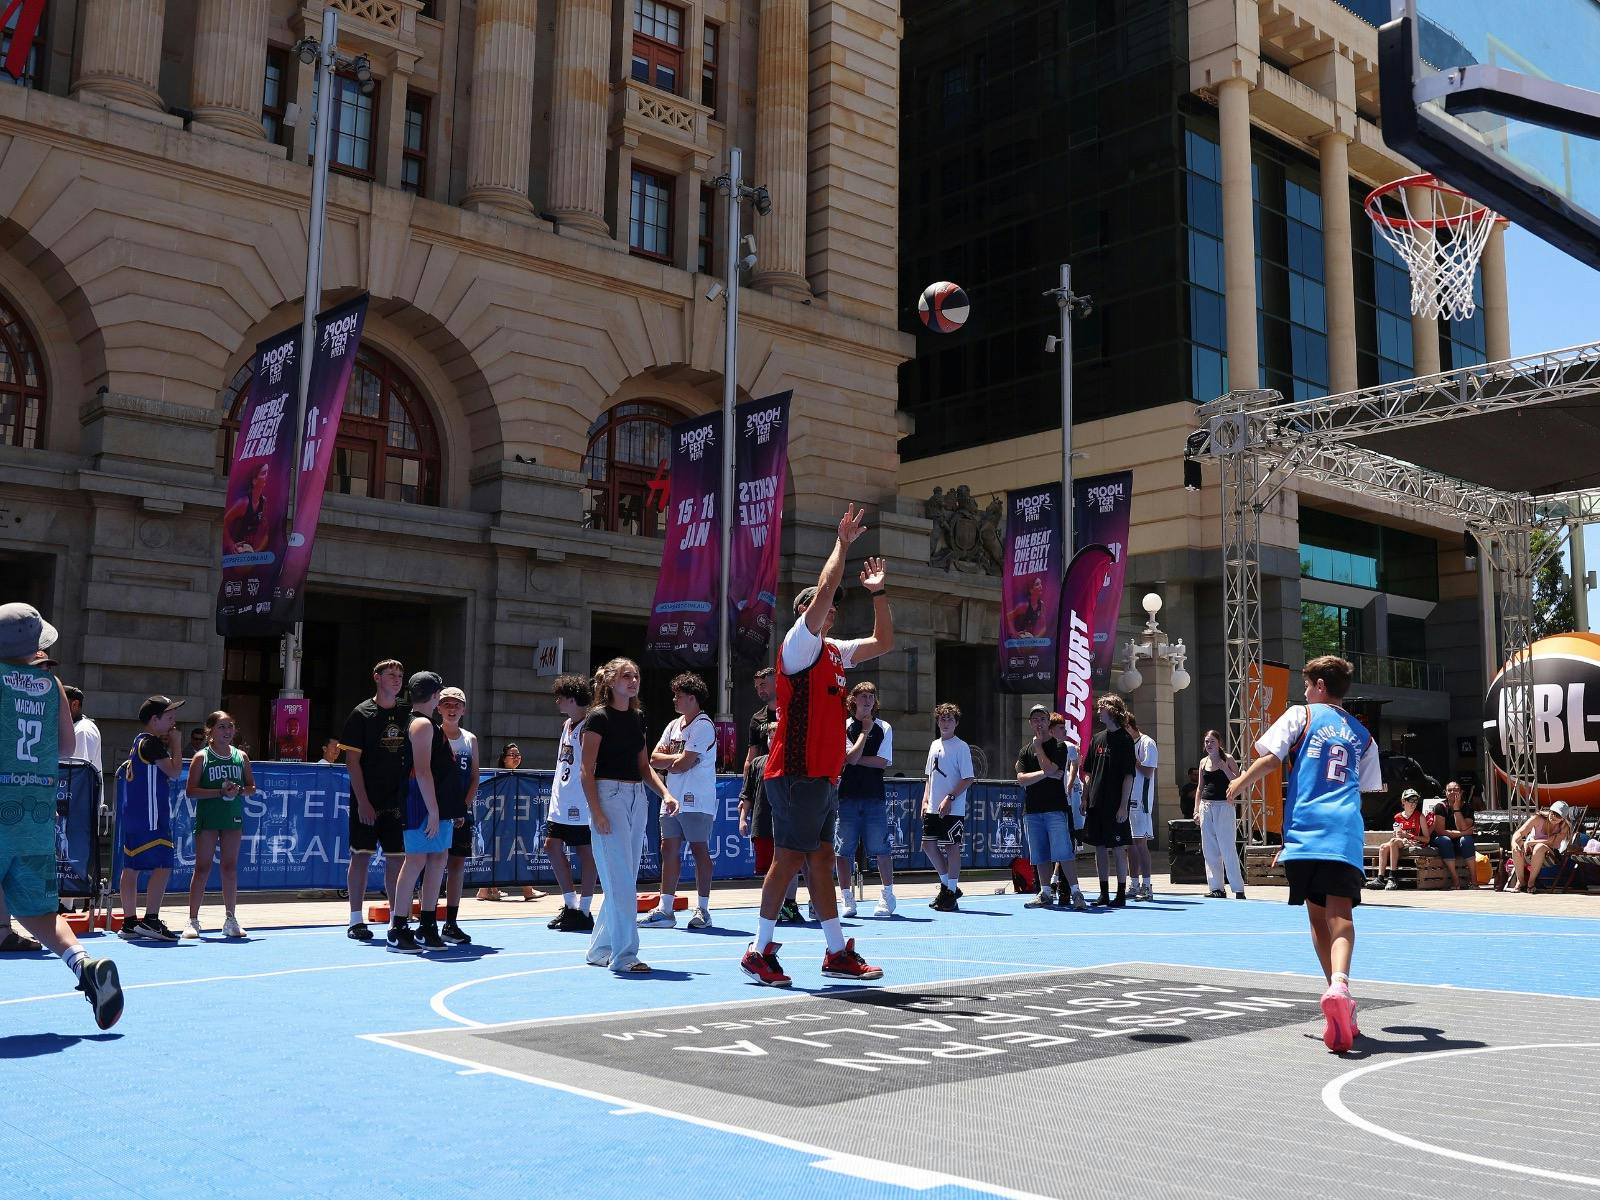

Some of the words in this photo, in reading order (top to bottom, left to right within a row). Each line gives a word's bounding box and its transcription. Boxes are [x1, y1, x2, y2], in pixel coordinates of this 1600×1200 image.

[262, 340, 294, 367] HOOPS
[681, 424, 713, 446] HOOPS
[689, 439, 705, 453] FEST
[1016, 492, 1050, 510] HOOPS
[1024, 504, 1041, 516] FEST
[1014, 534, 1031, 550] ONE
[1030, 529, 1052, 547] BEAT
[1014, 547, 1031, 562] ONE
[1030, 544, 1050, 560] CITY
[1012, 561, 1028, 577] ALL
[1028, 558, 1048, 574] BALL
[1065, 609, 1092, 722] COURT
[1498, 683, 1600, 756] NBL
[16, 718, 42, 763] 22
[208, 764, 242, 782] BOSTON
[460, 757, 467, 771] 5
[561, 767, 570, 782] 3
[1327, 744, 1349, 784] 2
[169, 790, 349, 818] WSTER
[602, 1013, 832, 1042] DREAM
[672, 984, 1237, 1056] AUSTRALIA
[816, 996, 1319, 1072] WESTERN
